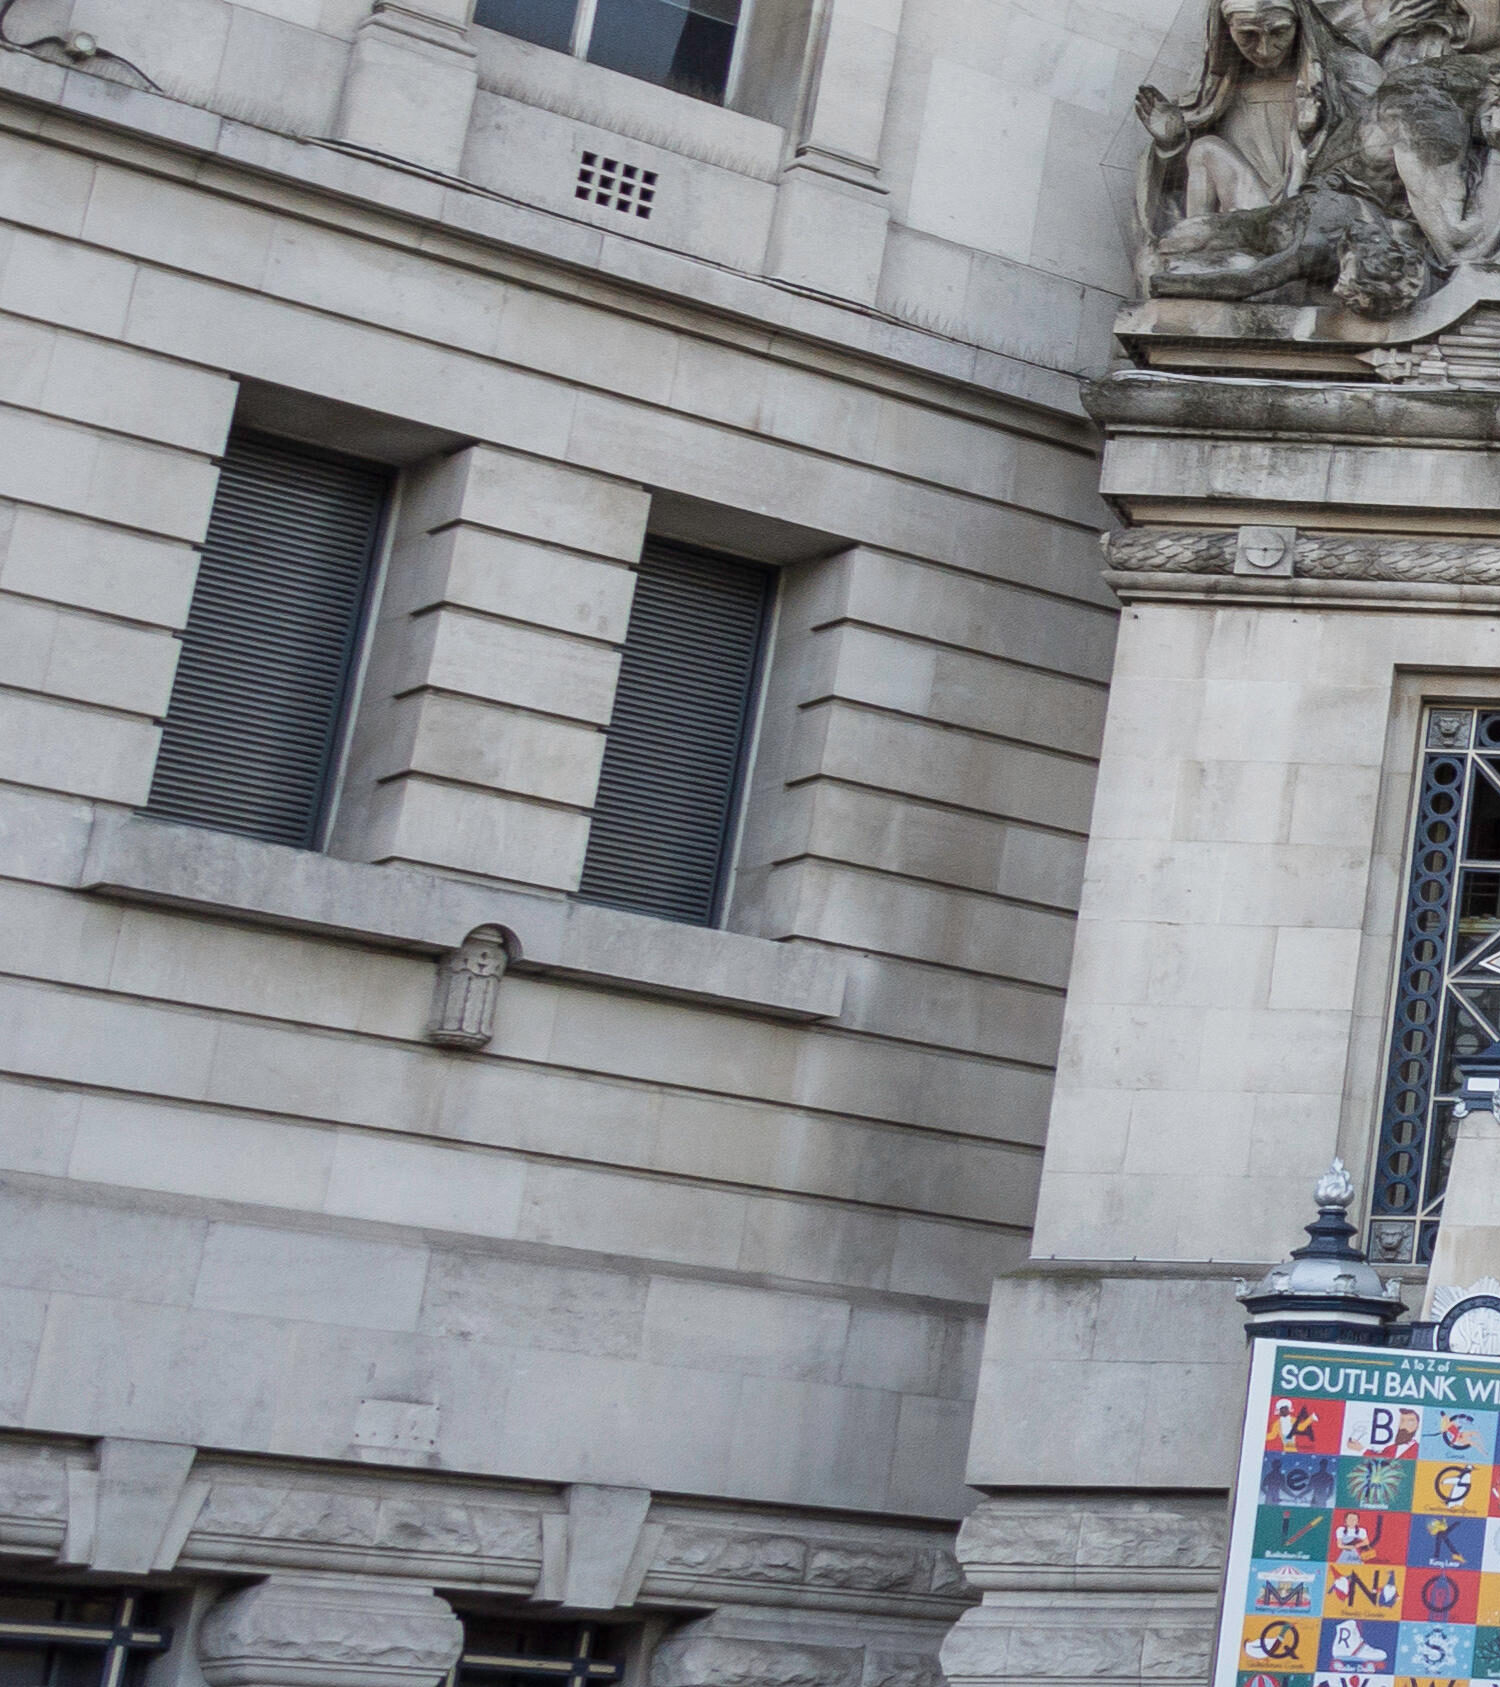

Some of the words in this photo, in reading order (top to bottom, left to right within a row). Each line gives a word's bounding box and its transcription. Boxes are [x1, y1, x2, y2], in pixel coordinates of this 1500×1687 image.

[1280, 1364, 1379, 1396] SOUTH
[1384, 1370, 1456, 1402] BANK
[1401, 1359, 1410, 1370] A
[1413, 1359, 1424, 1371] to
[1427, 1360, 1435, 1372] Z
[1437, 1360, 1451, 1373] of
[1370, 1407, 1394, 1445] B
[1263, 1579, 1305, 1607] M
[1348, 1569, 1379, 1607] N
[1260, 1620, 1300, 1660] Q
[1338, 1627, 1351, 1649] R
[1424, 1627, 1448, 1665] S
